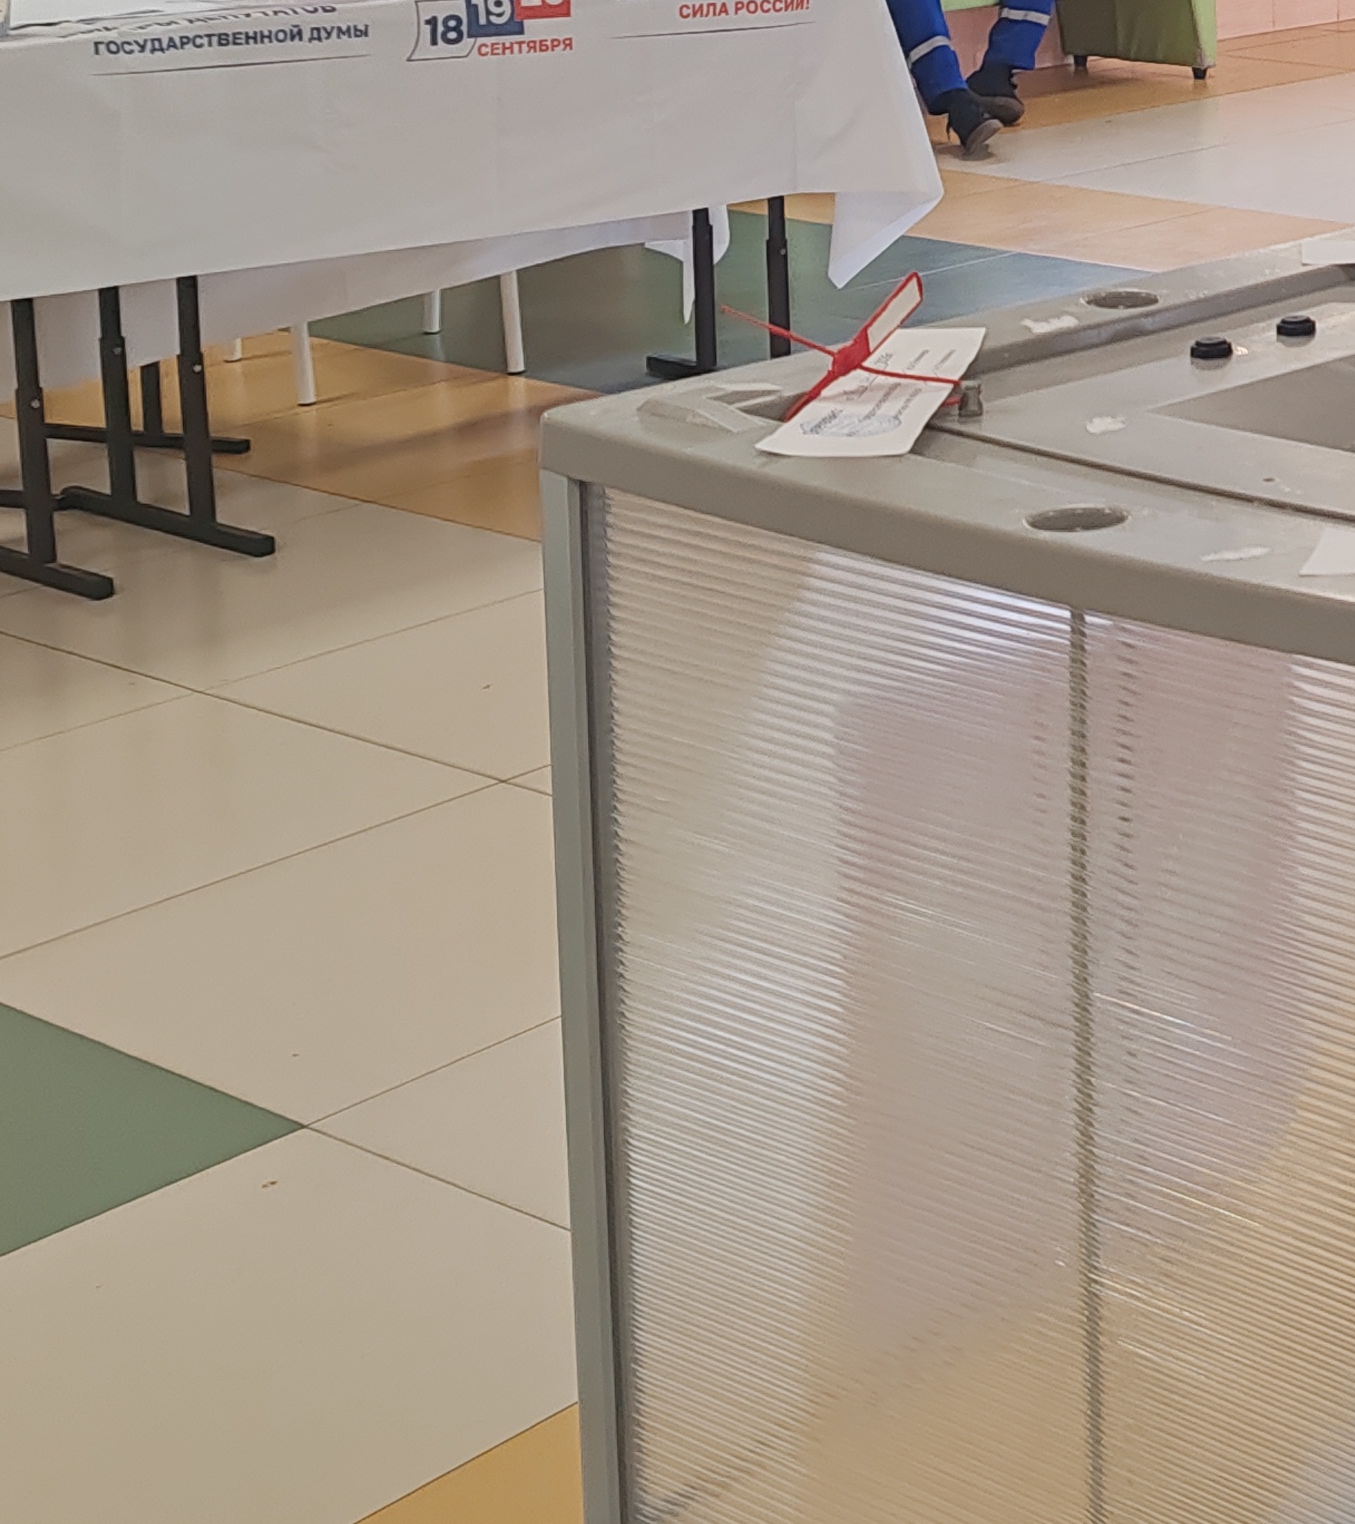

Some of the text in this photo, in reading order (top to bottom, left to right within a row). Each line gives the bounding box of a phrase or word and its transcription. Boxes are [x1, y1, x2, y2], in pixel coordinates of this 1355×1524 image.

[678, 2, 730, 20] СИЛА
[93, 23, 370, 56] ГОСУДАРСТВЕННОЙ ДУМЫ
[424, 14, 464, 47] 18
[477, 37, 573, 57] СЕНТЯБРЯ
